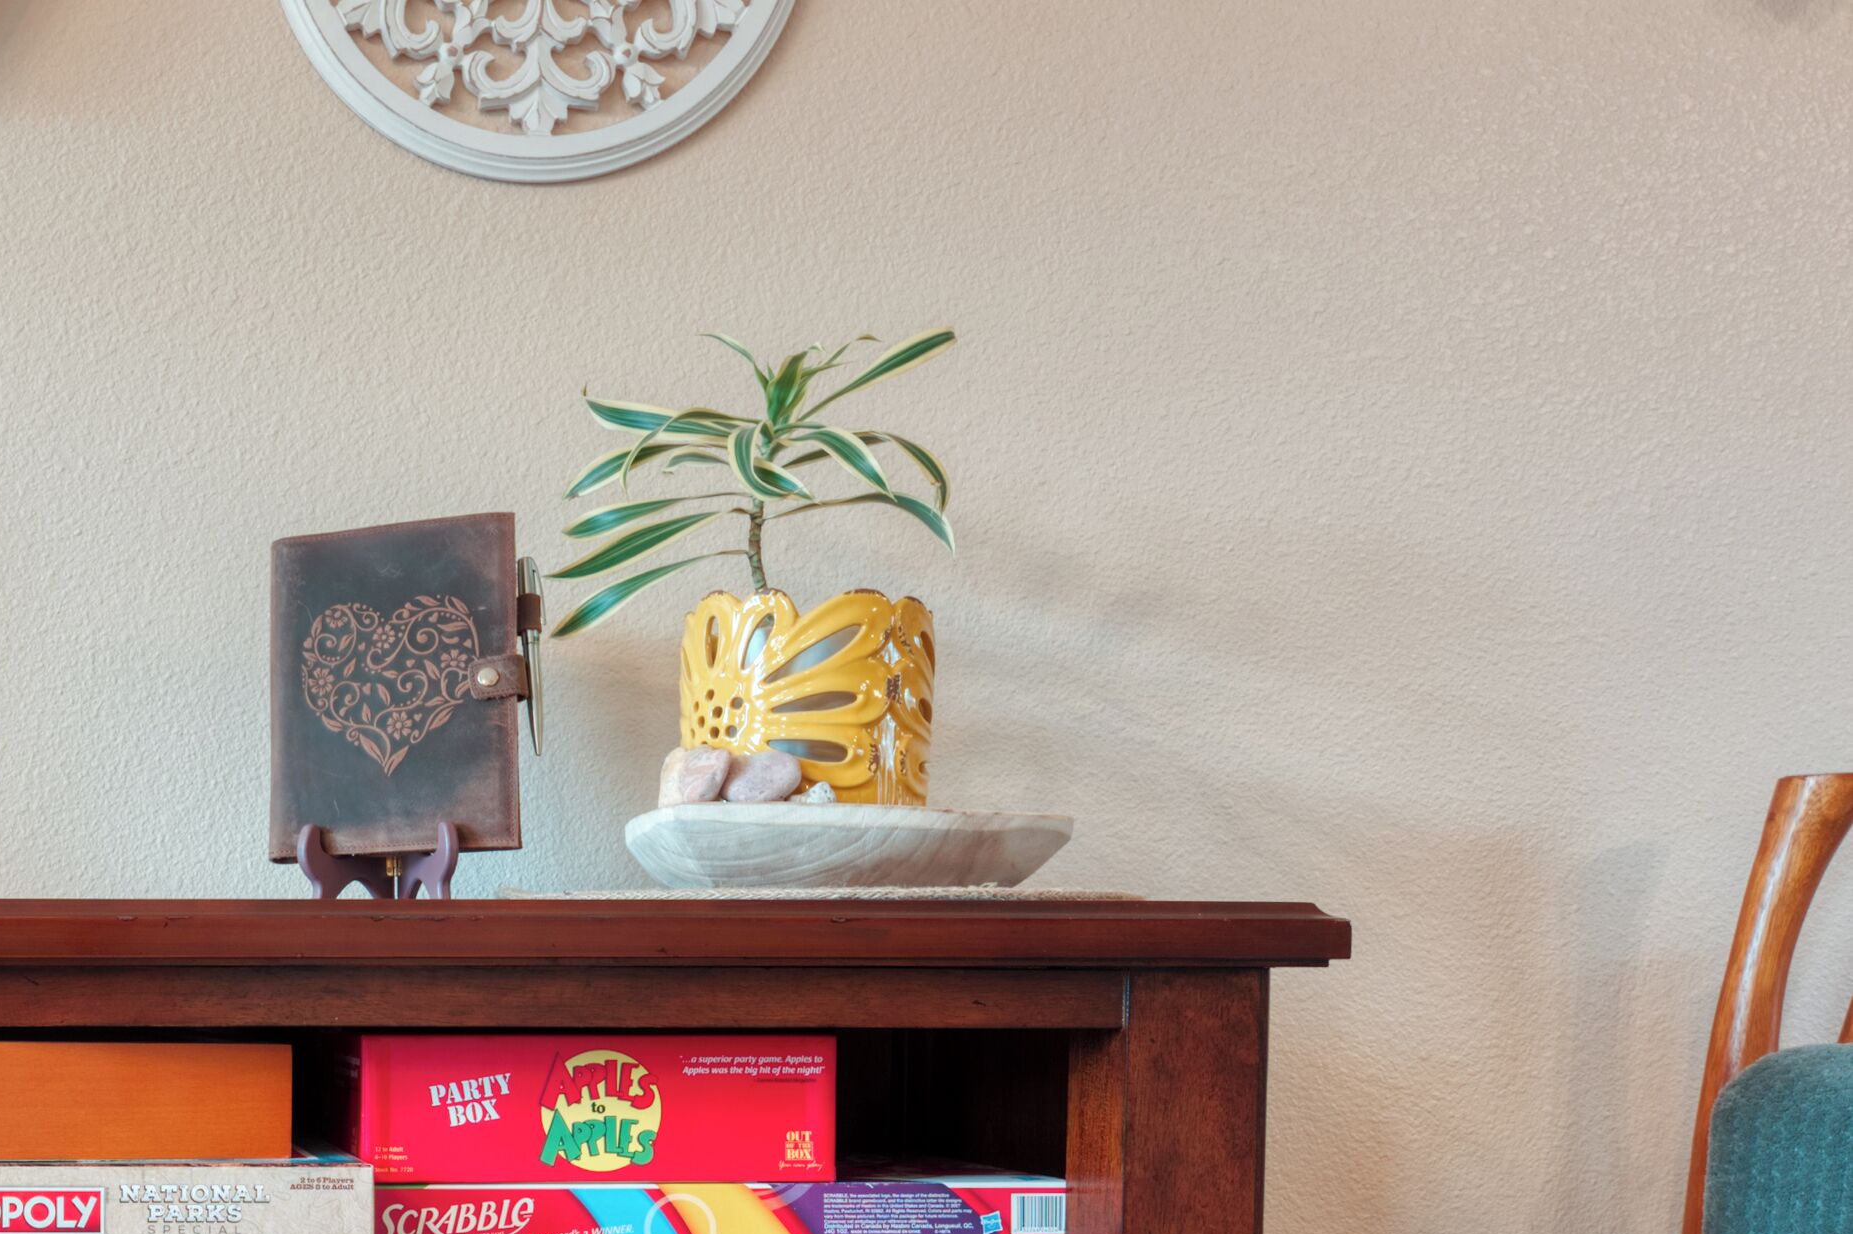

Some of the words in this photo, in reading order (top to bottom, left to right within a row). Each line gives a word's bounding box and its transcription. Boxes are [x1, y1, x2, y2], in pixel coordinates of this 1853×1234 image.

[698, 1055, 733, 1065] superior
[734, 1055, 757, 1065] party
[758, 1056, 783, 1065] game.
[785, 1055, 812, 1065] Apples
[814, 1055, 823, 1063] to
[682, 1066, 710, 1076] Apples
[729, 1066, 744, 1074] the
[744, 1066, 758, 1076] big
[759, 1066, 771, 1074] hit
[771, 1066, 781, 1076] of
[782, 1066, 795, 1074] the
[428, 1073, 511, 1107] PARTY
[447, 1099, 500, 1127] BOX
[591, 1101, 606, 1114] to
[539, 1108, 658, 1167] APPLES
[786, 1130, 812, 1141] OUT
[388, 1153, 408, 1161] Players
[787, 1149, 812, 1159] BOX
[322, 1176, 354, 1184] Players
[119, 1184, 270, 1203] NATIONAL
[147, 1203, 242, 1223] PARKS
[147, 1224, 242, 1234] SPECIAL
